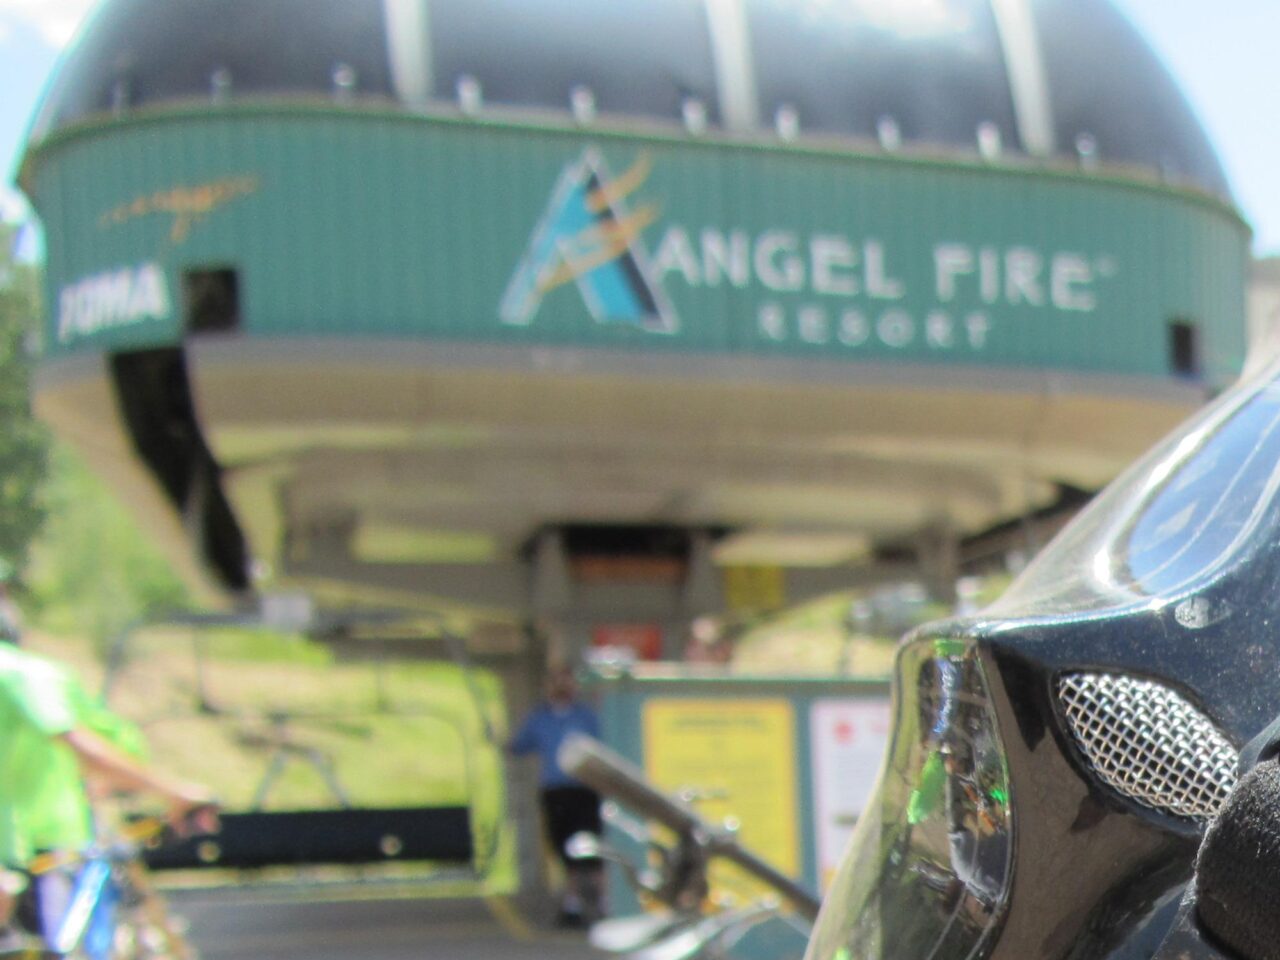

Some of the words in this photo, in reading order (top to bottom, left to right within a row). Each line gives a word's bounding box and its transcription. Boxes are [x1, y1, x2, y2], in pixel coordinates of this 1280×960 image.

[654, 226, 903, 299] ANGEL
[934, 242, 1097, 312] FIRE
[759, 302, 991, 349] RESORT
